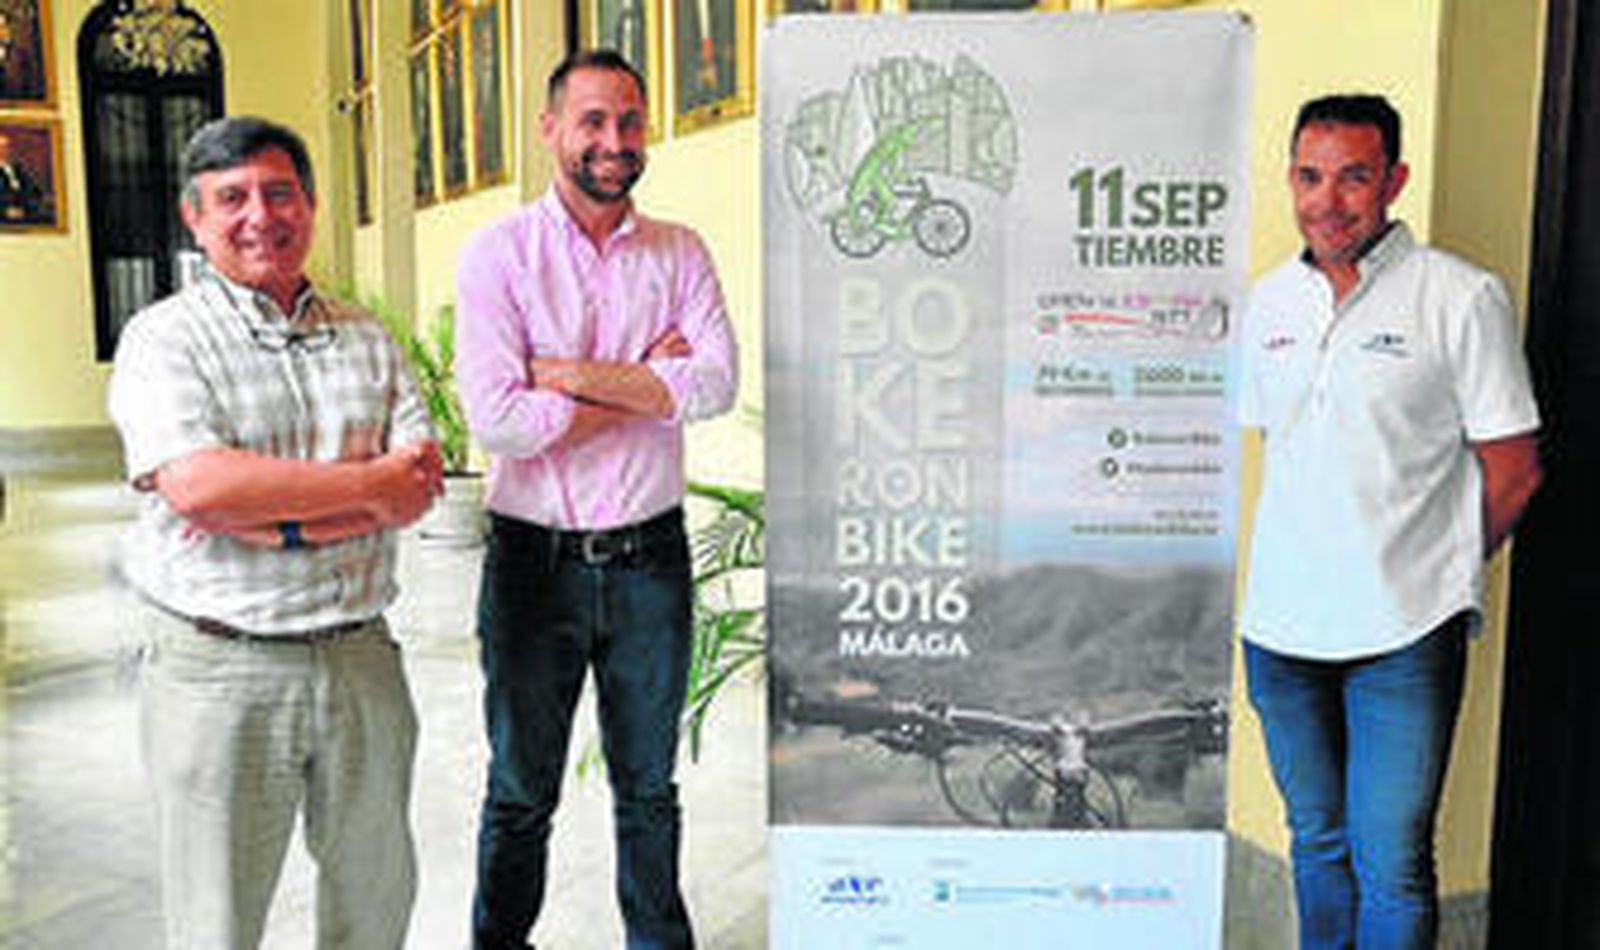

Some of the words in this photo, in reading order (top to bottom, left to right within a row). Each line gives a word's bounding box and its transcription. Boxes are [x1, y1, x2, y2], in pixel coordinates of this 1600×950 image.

[1129, 182, 1229, 228] SEP
[1073, 234, 1225, 268] TIEMBRE
[838, 277, 970, 354] BO
[837, 360, 966, 450] KE
[837, 458, 968, 508] RON
[837, 517, 967, 566] BIKE
[838, 575, 970, 623] 2016
[838, 624, 971, 657] MÁLAGA
